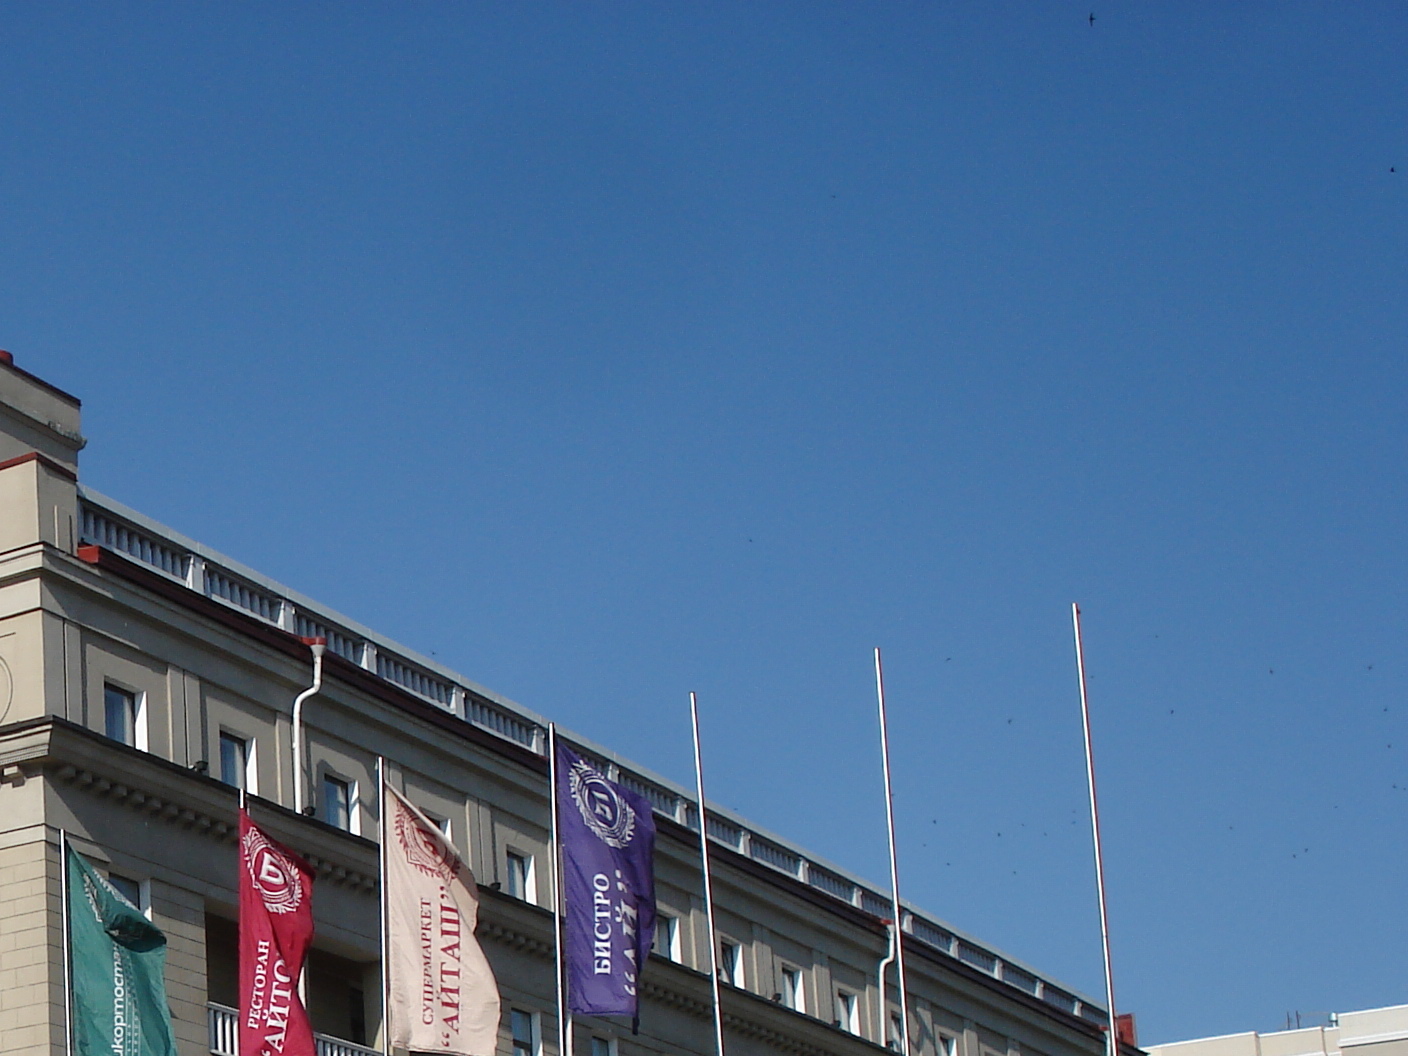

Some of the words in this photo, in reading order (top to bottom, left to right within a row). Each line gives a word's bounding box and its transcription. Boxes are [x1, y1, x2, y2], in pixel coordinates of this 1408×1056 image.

[420, 897, 434, 1026] СУПЕРМАРКЕТ
[593, 873, 612, 975] БИСТРО
[248, 940, 270, 1030] РЕСТОРАН
